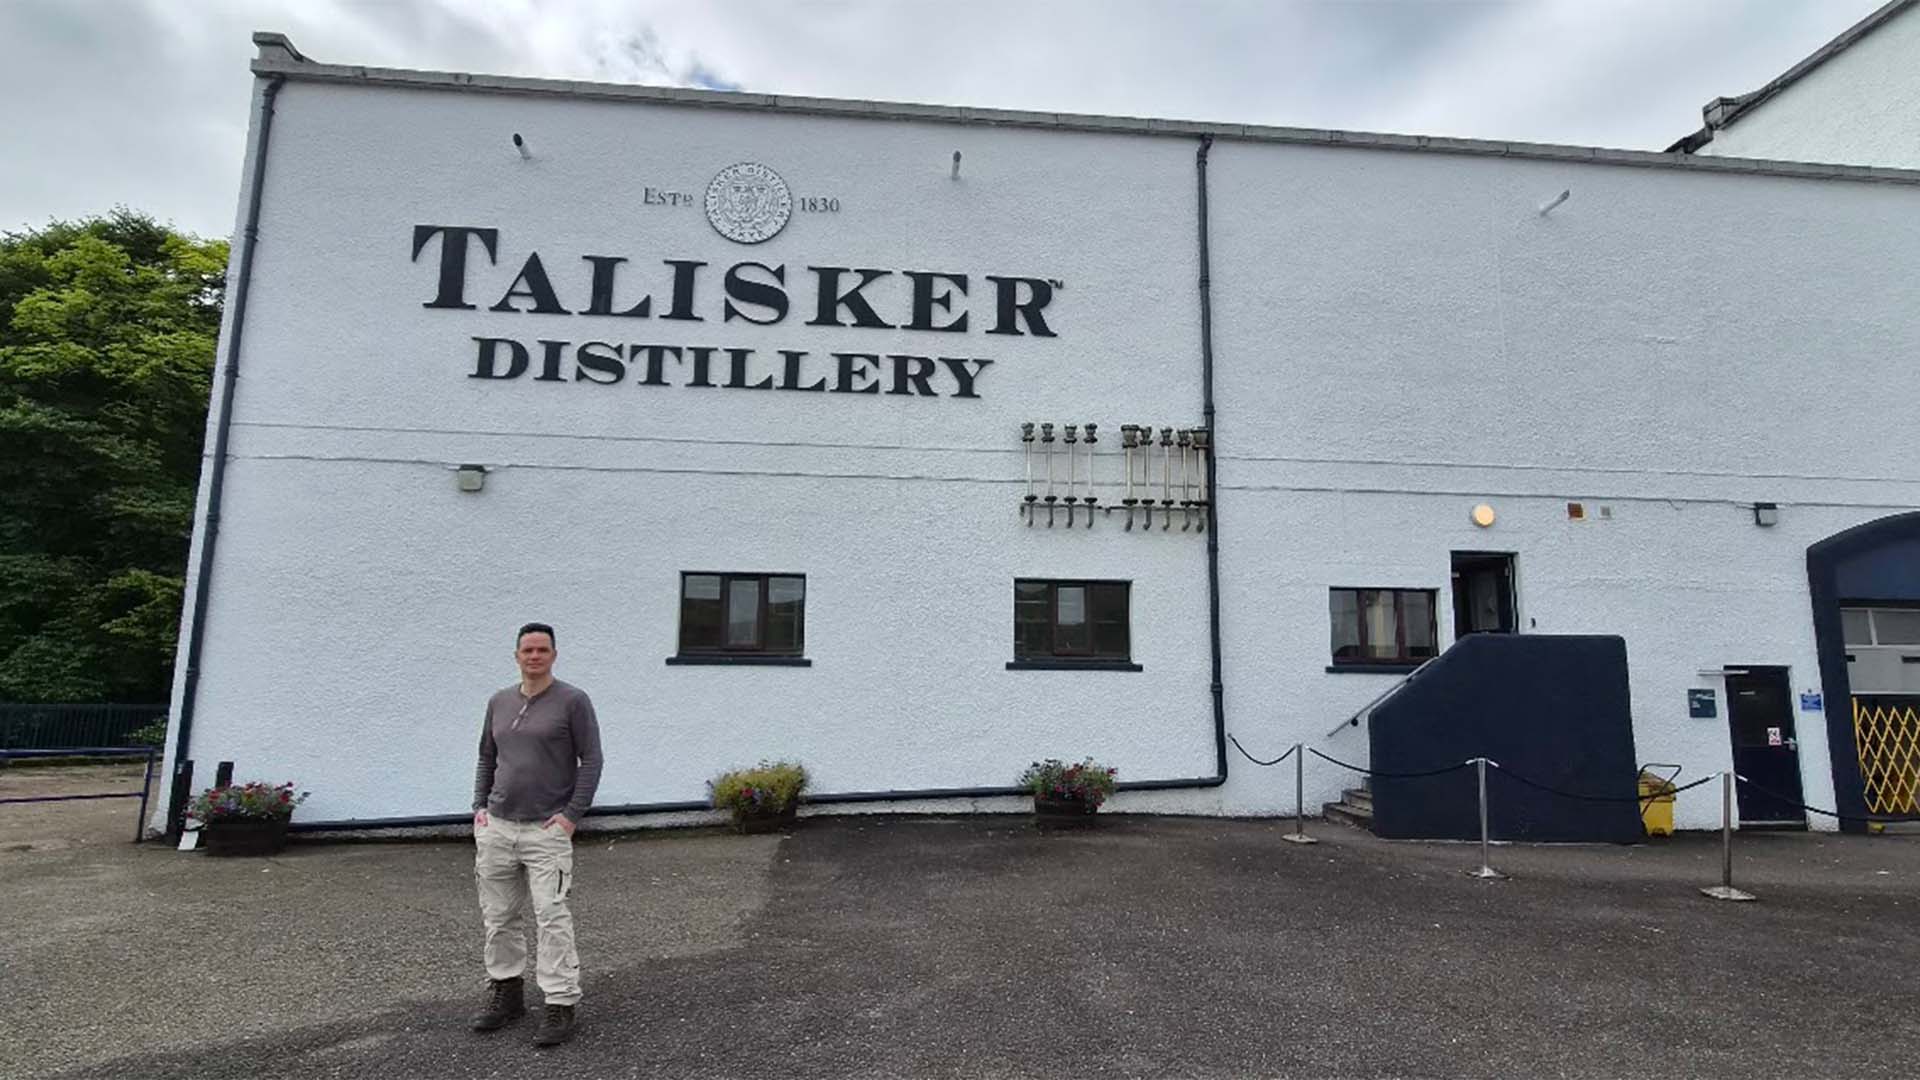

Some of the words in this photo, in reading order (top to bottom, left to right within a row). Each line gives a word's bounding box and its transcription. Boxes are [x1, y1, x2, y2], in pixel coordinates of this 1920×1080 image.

[800, 197, 841, 213] 1830
[412, 225, 1058, 337] TALISKER
[468, 336, 994, 398] DISTILLERY
